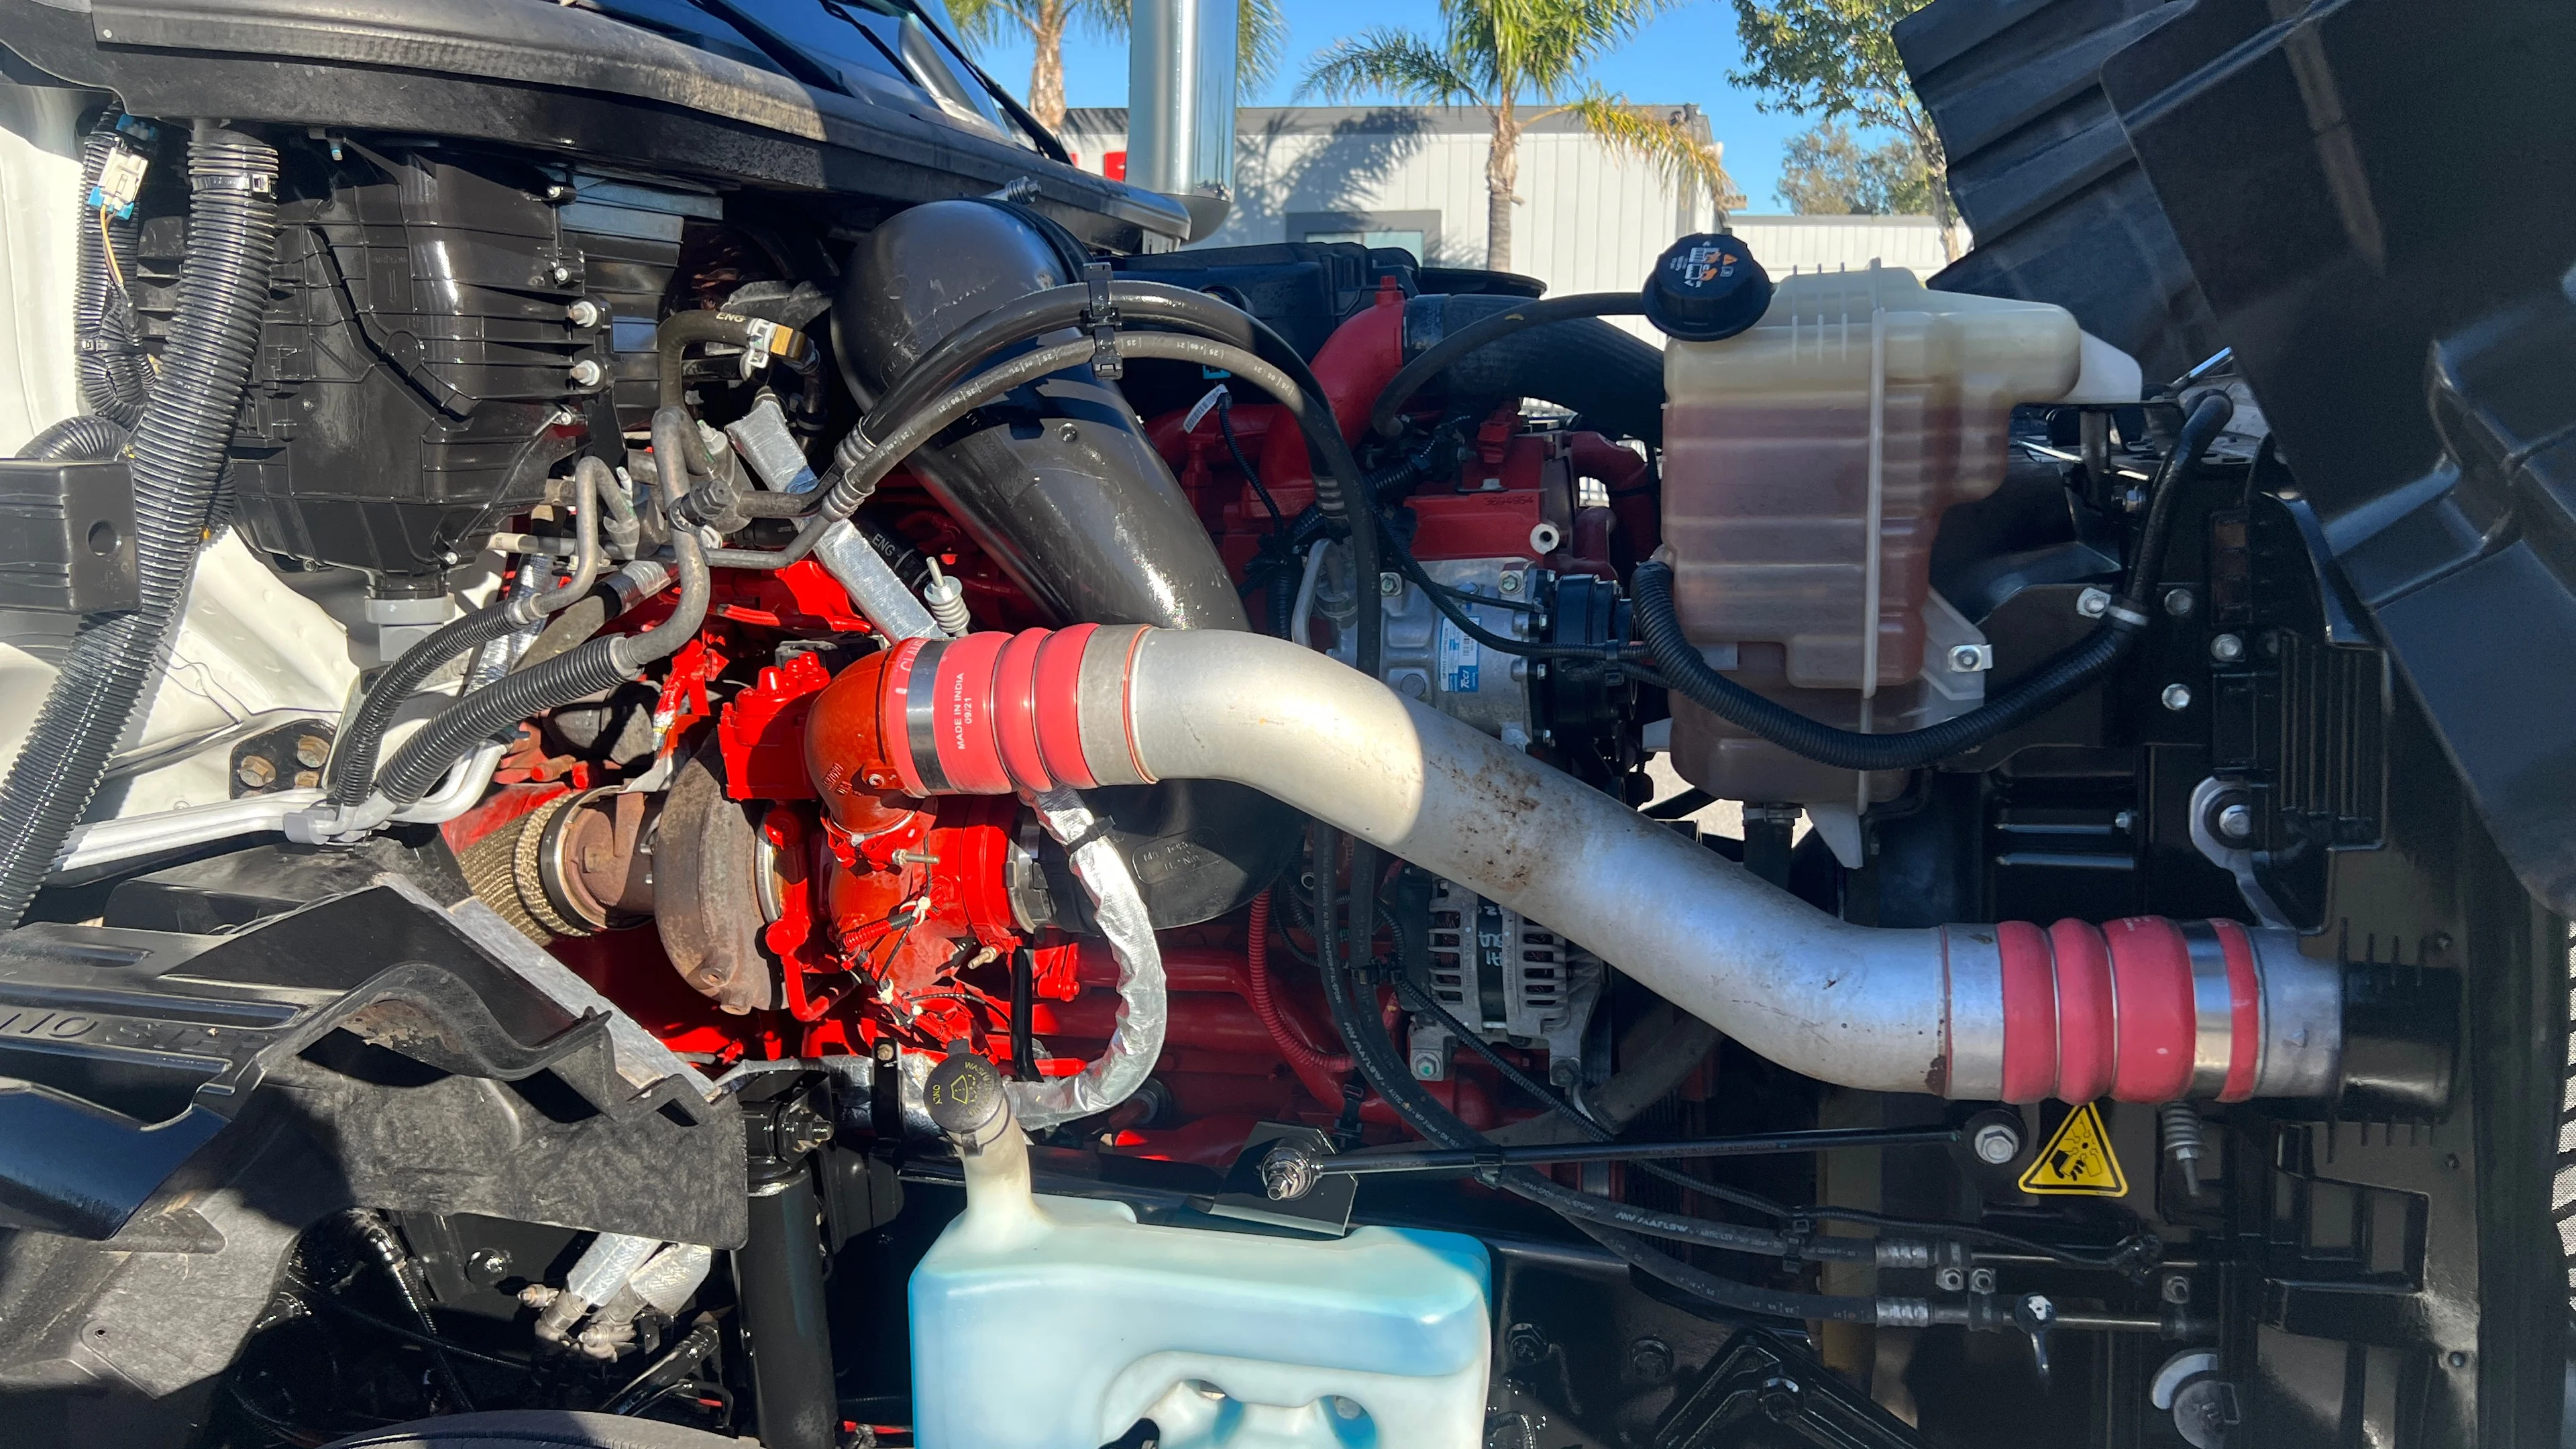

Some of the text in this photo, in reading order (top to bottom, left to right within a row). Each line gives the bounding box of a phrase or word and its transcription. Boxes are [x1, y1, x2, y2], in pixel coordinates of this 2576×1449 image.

[716, 312, 746, 323] ENG
[1042, 353, 1053, 361] 25
[1209, 348, 1219, 356] 25
[966, 387, 975, 396] 25
[872, 533, 896, 556] ENG
[954, 673, 965, 749] MADE IN INDIA
[963, 698, 973, 724] 09/21
[932, 1084, 943, 1105] ONLY
